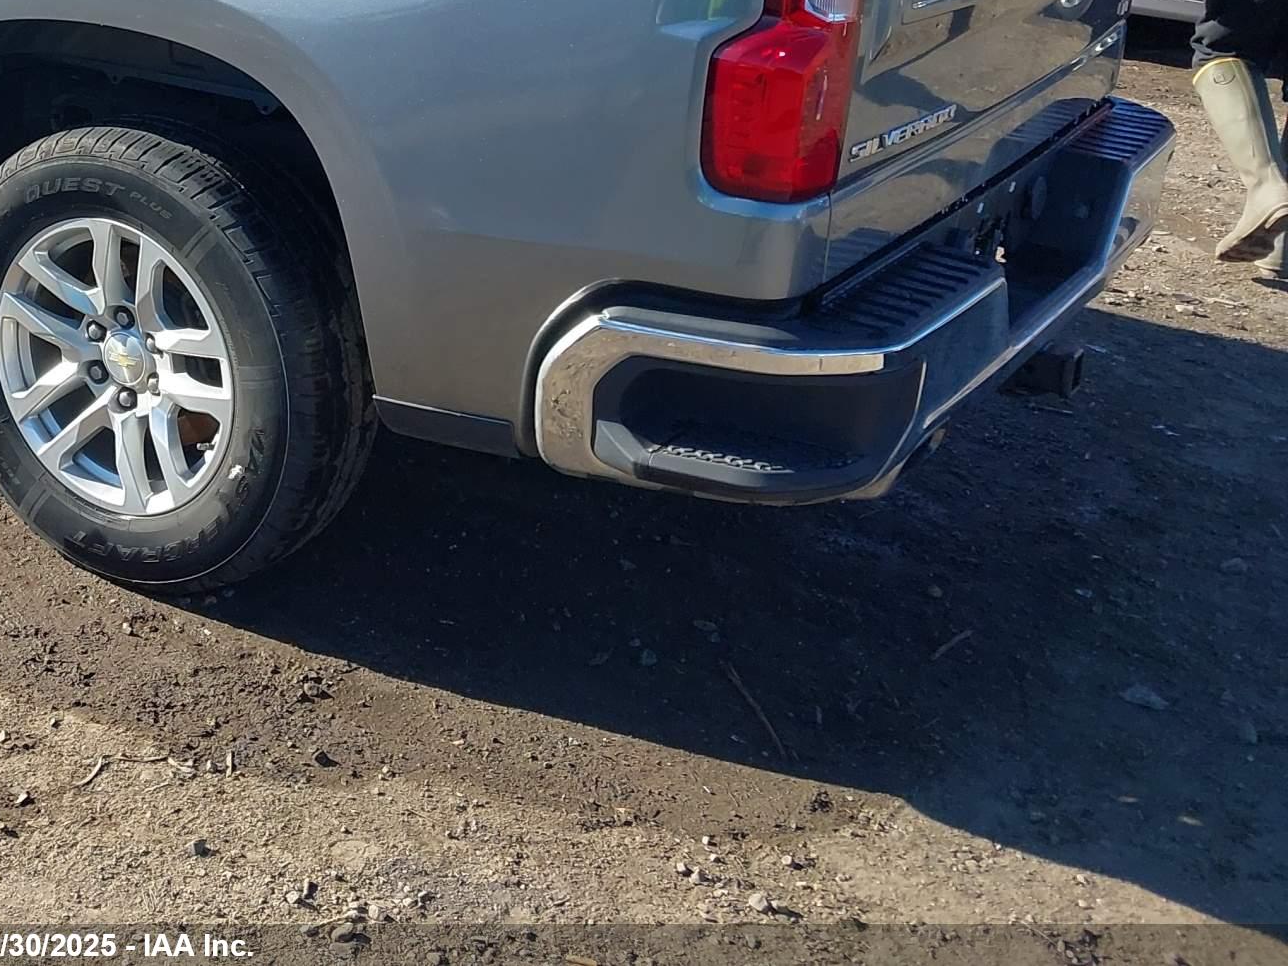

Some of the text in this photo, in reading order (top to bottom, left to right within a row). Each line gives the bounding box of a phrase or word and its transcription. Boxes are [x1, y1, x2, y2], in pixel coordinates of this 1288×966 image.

[848, 103, 958, 163] SILVERADO
[23, 176, 126, 204] QUEST
[128, 190, 174, 220] PLUS
